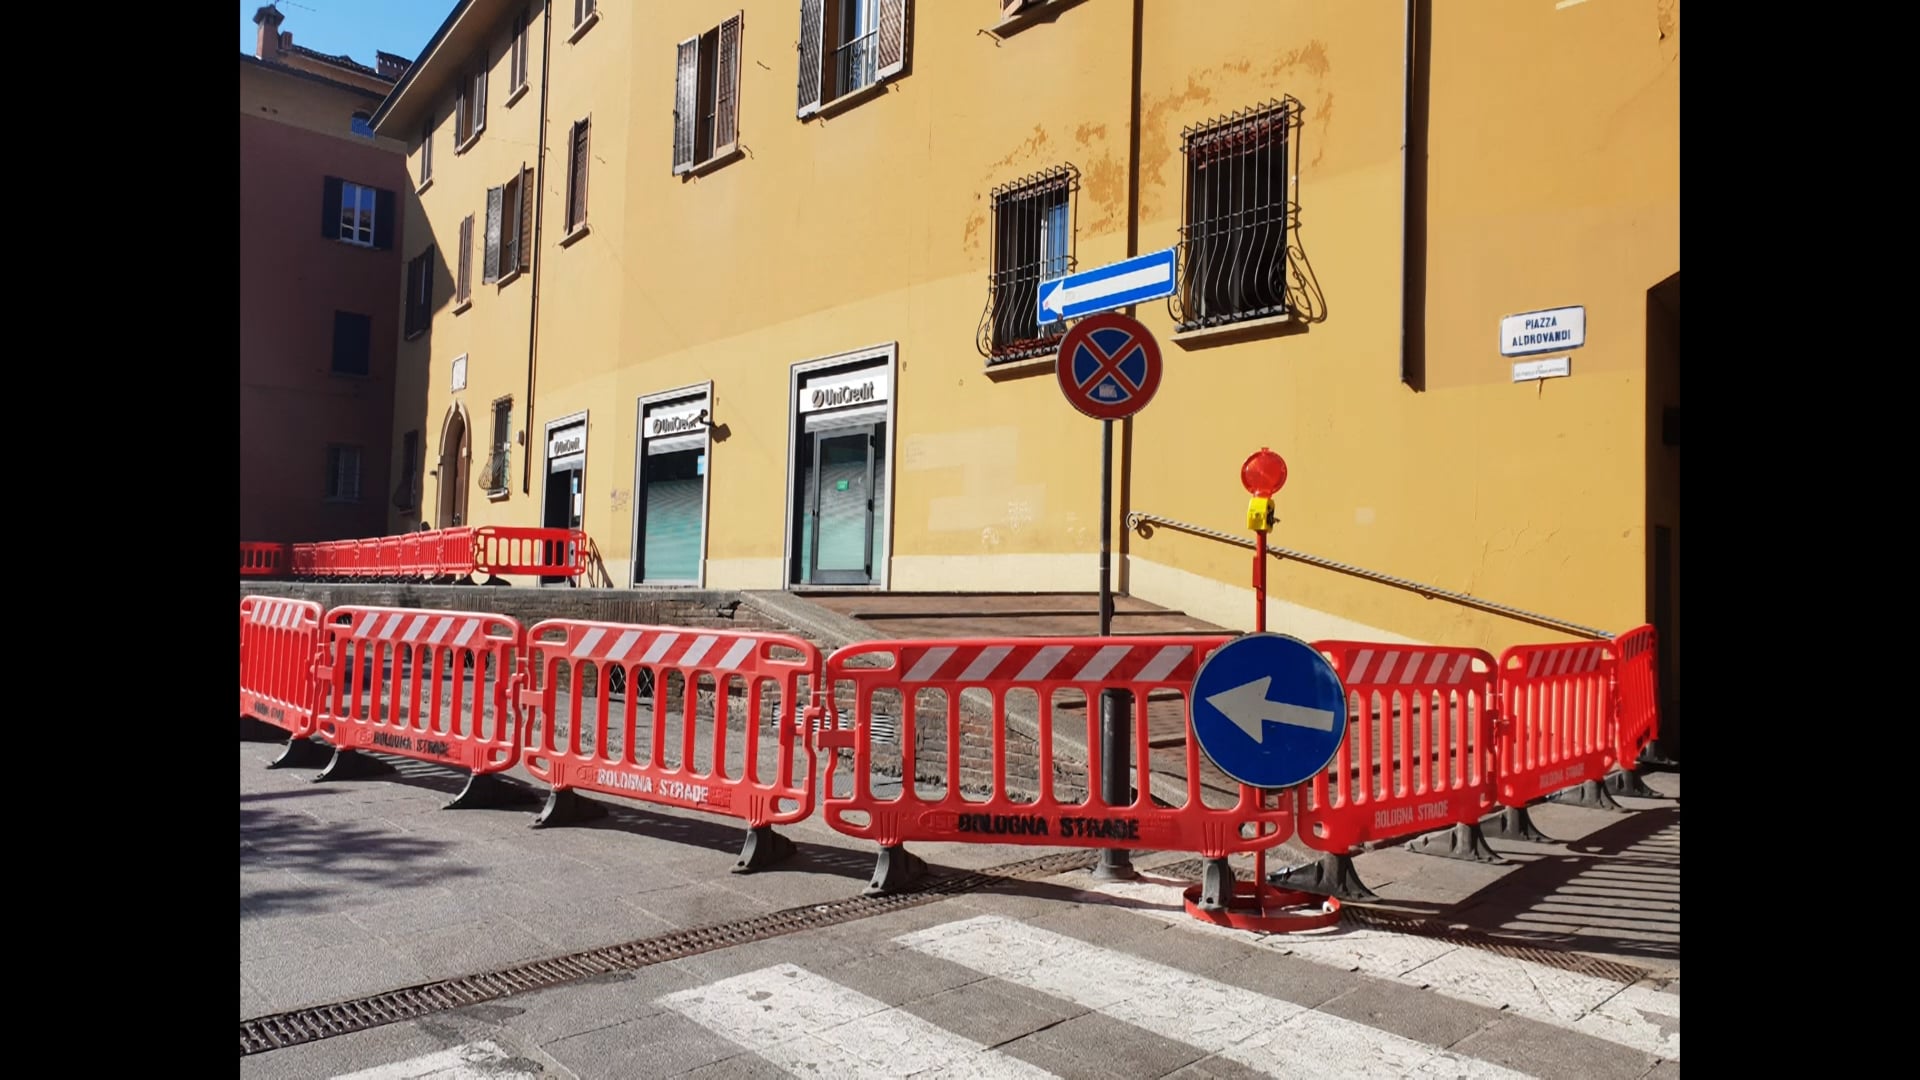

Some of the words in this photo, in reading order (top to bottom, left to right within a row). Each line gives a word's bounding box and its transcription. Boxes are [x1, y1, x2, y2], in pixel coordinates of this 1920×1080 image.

[1525, 316, 1557, 330] PIAZZA
[1512, 329, 1571, 347] ALDROVANDI
[825, 381, 875, 407] UniCredit
[598, 768, 653, 793] BOLOGNA
[659, 779, 708, 803] STRADE
[958, 812, 1048, 836] BOLOGNA
[1060, 817, 1140, 841] STRADE
[1374, 805, 1414, 829] BOLOGNA
[1417, 800, 1449, 821] STRADE
